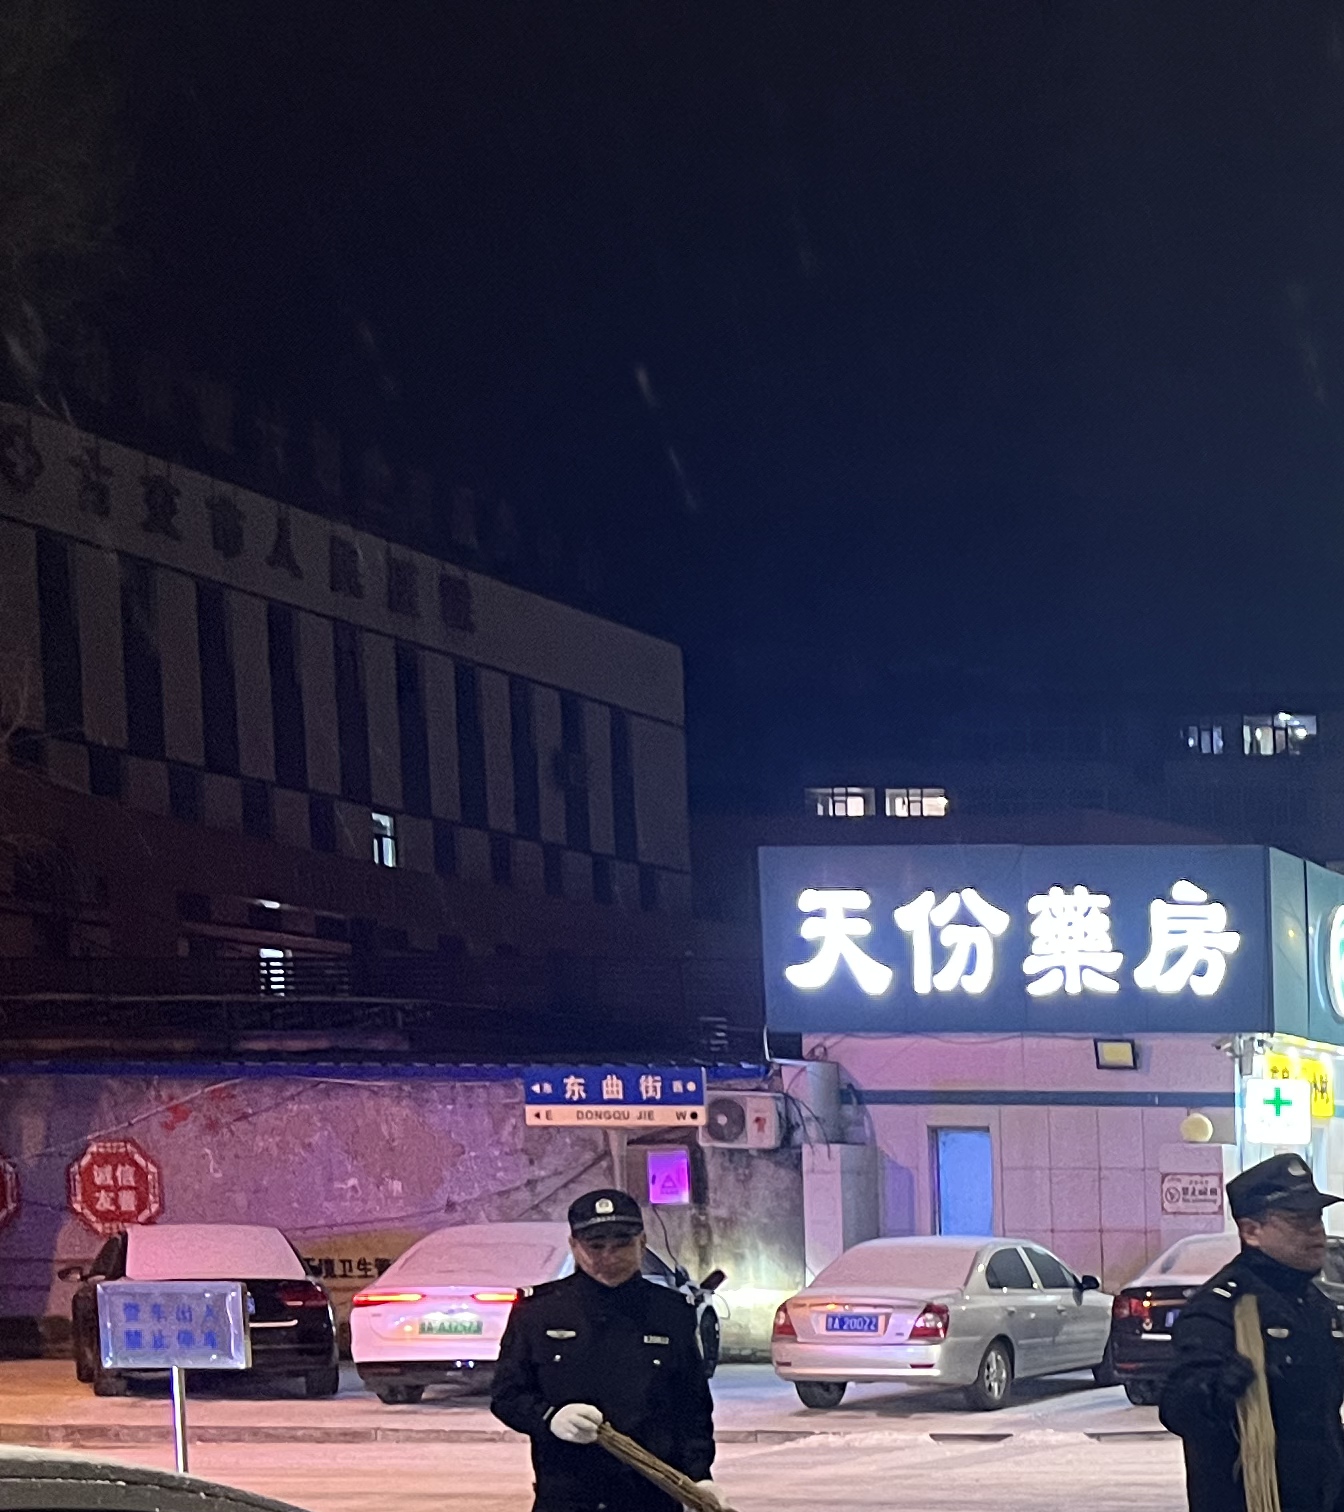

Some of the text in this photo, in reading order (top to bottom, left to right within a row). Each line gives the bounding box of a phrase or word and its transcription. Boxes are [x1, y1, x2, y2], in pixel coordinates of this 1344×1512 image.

[563, 1074, 662, 1100] 东曲街
[545, 1110, 687, 1121] E DONGQU JIE W
